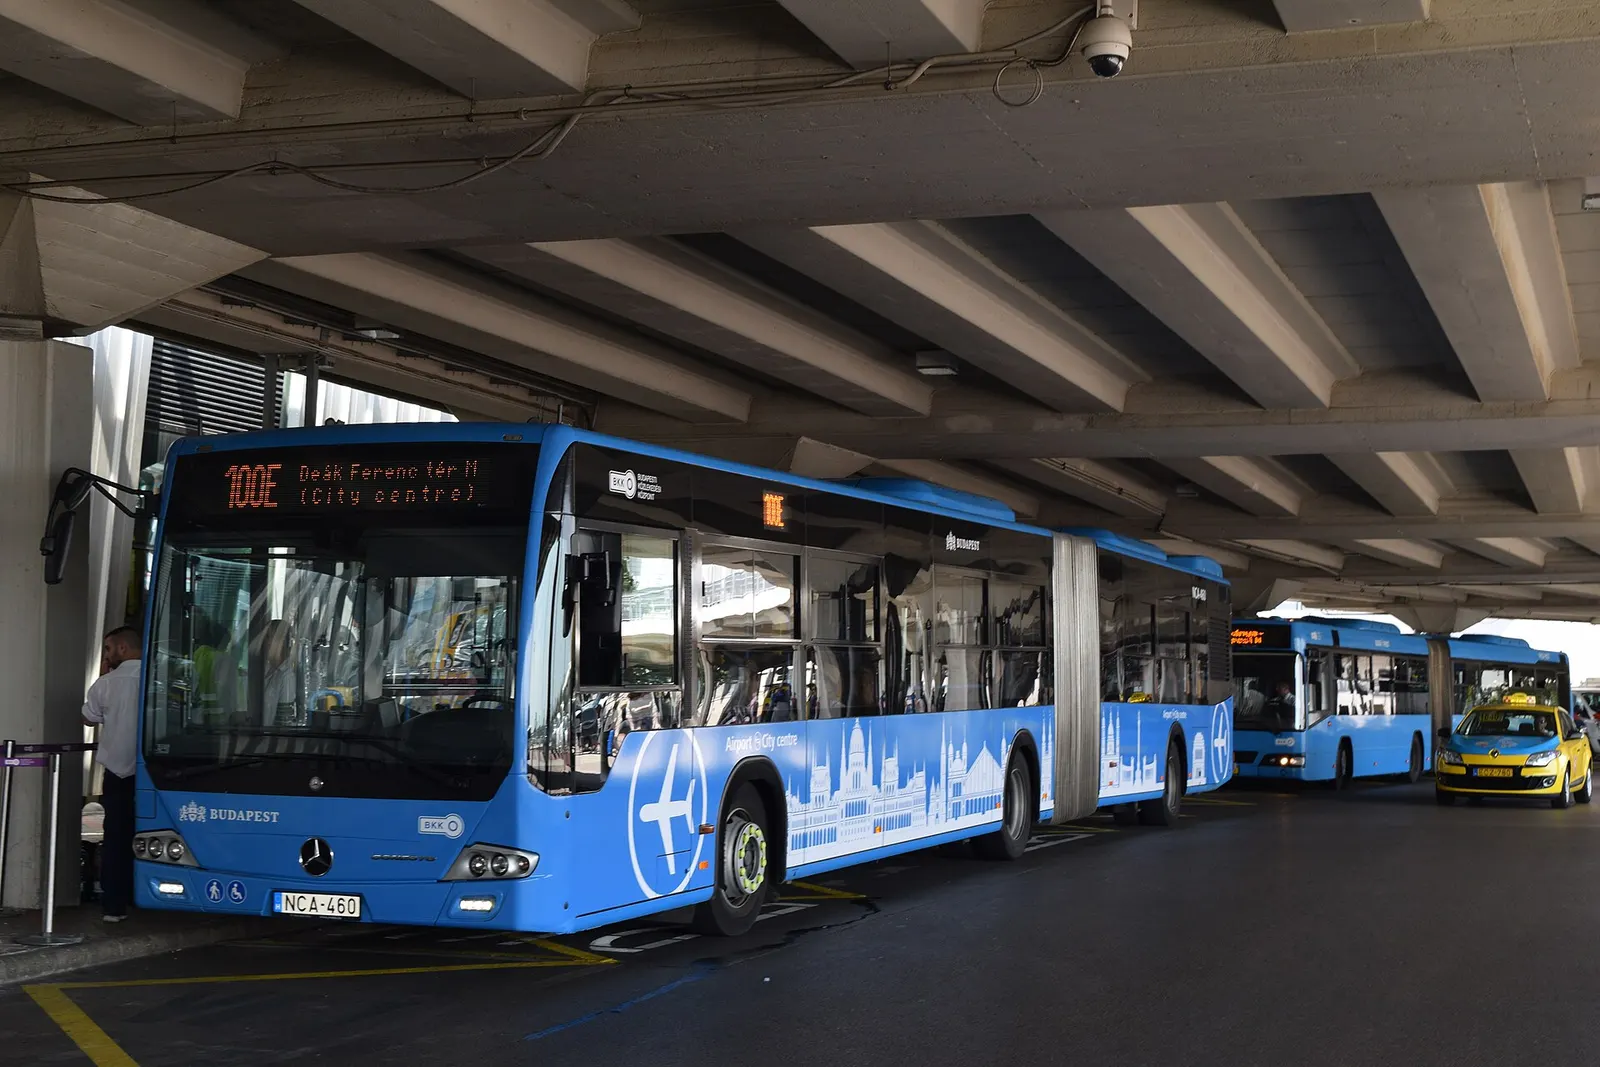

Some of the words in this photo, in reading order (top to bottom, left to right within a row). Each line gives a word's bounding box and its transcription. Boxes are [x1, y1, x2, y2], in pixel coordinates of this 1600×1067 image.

[299, 464, 343, 482] Deák
[350, 463, 419, 481] Ferenc
[426, 460, 458, 479] tér
[465, 460, 478, 477] M
[224, 463, 283, 508] 100E
[300, 487, 361, 506] (City
[374, 483, 474, 503] centre)
[956, 537, 980, 551] BUDAPEST
[725, 735, 753, 753] Airport
[761, 733, 776, 751] City
[776, 732, 798, 747] centre
[210, 808, 280, 822] BUDAPEST
[424, 821, 444, 830] BKK
[284, 894, 356, 915] NCA-460
